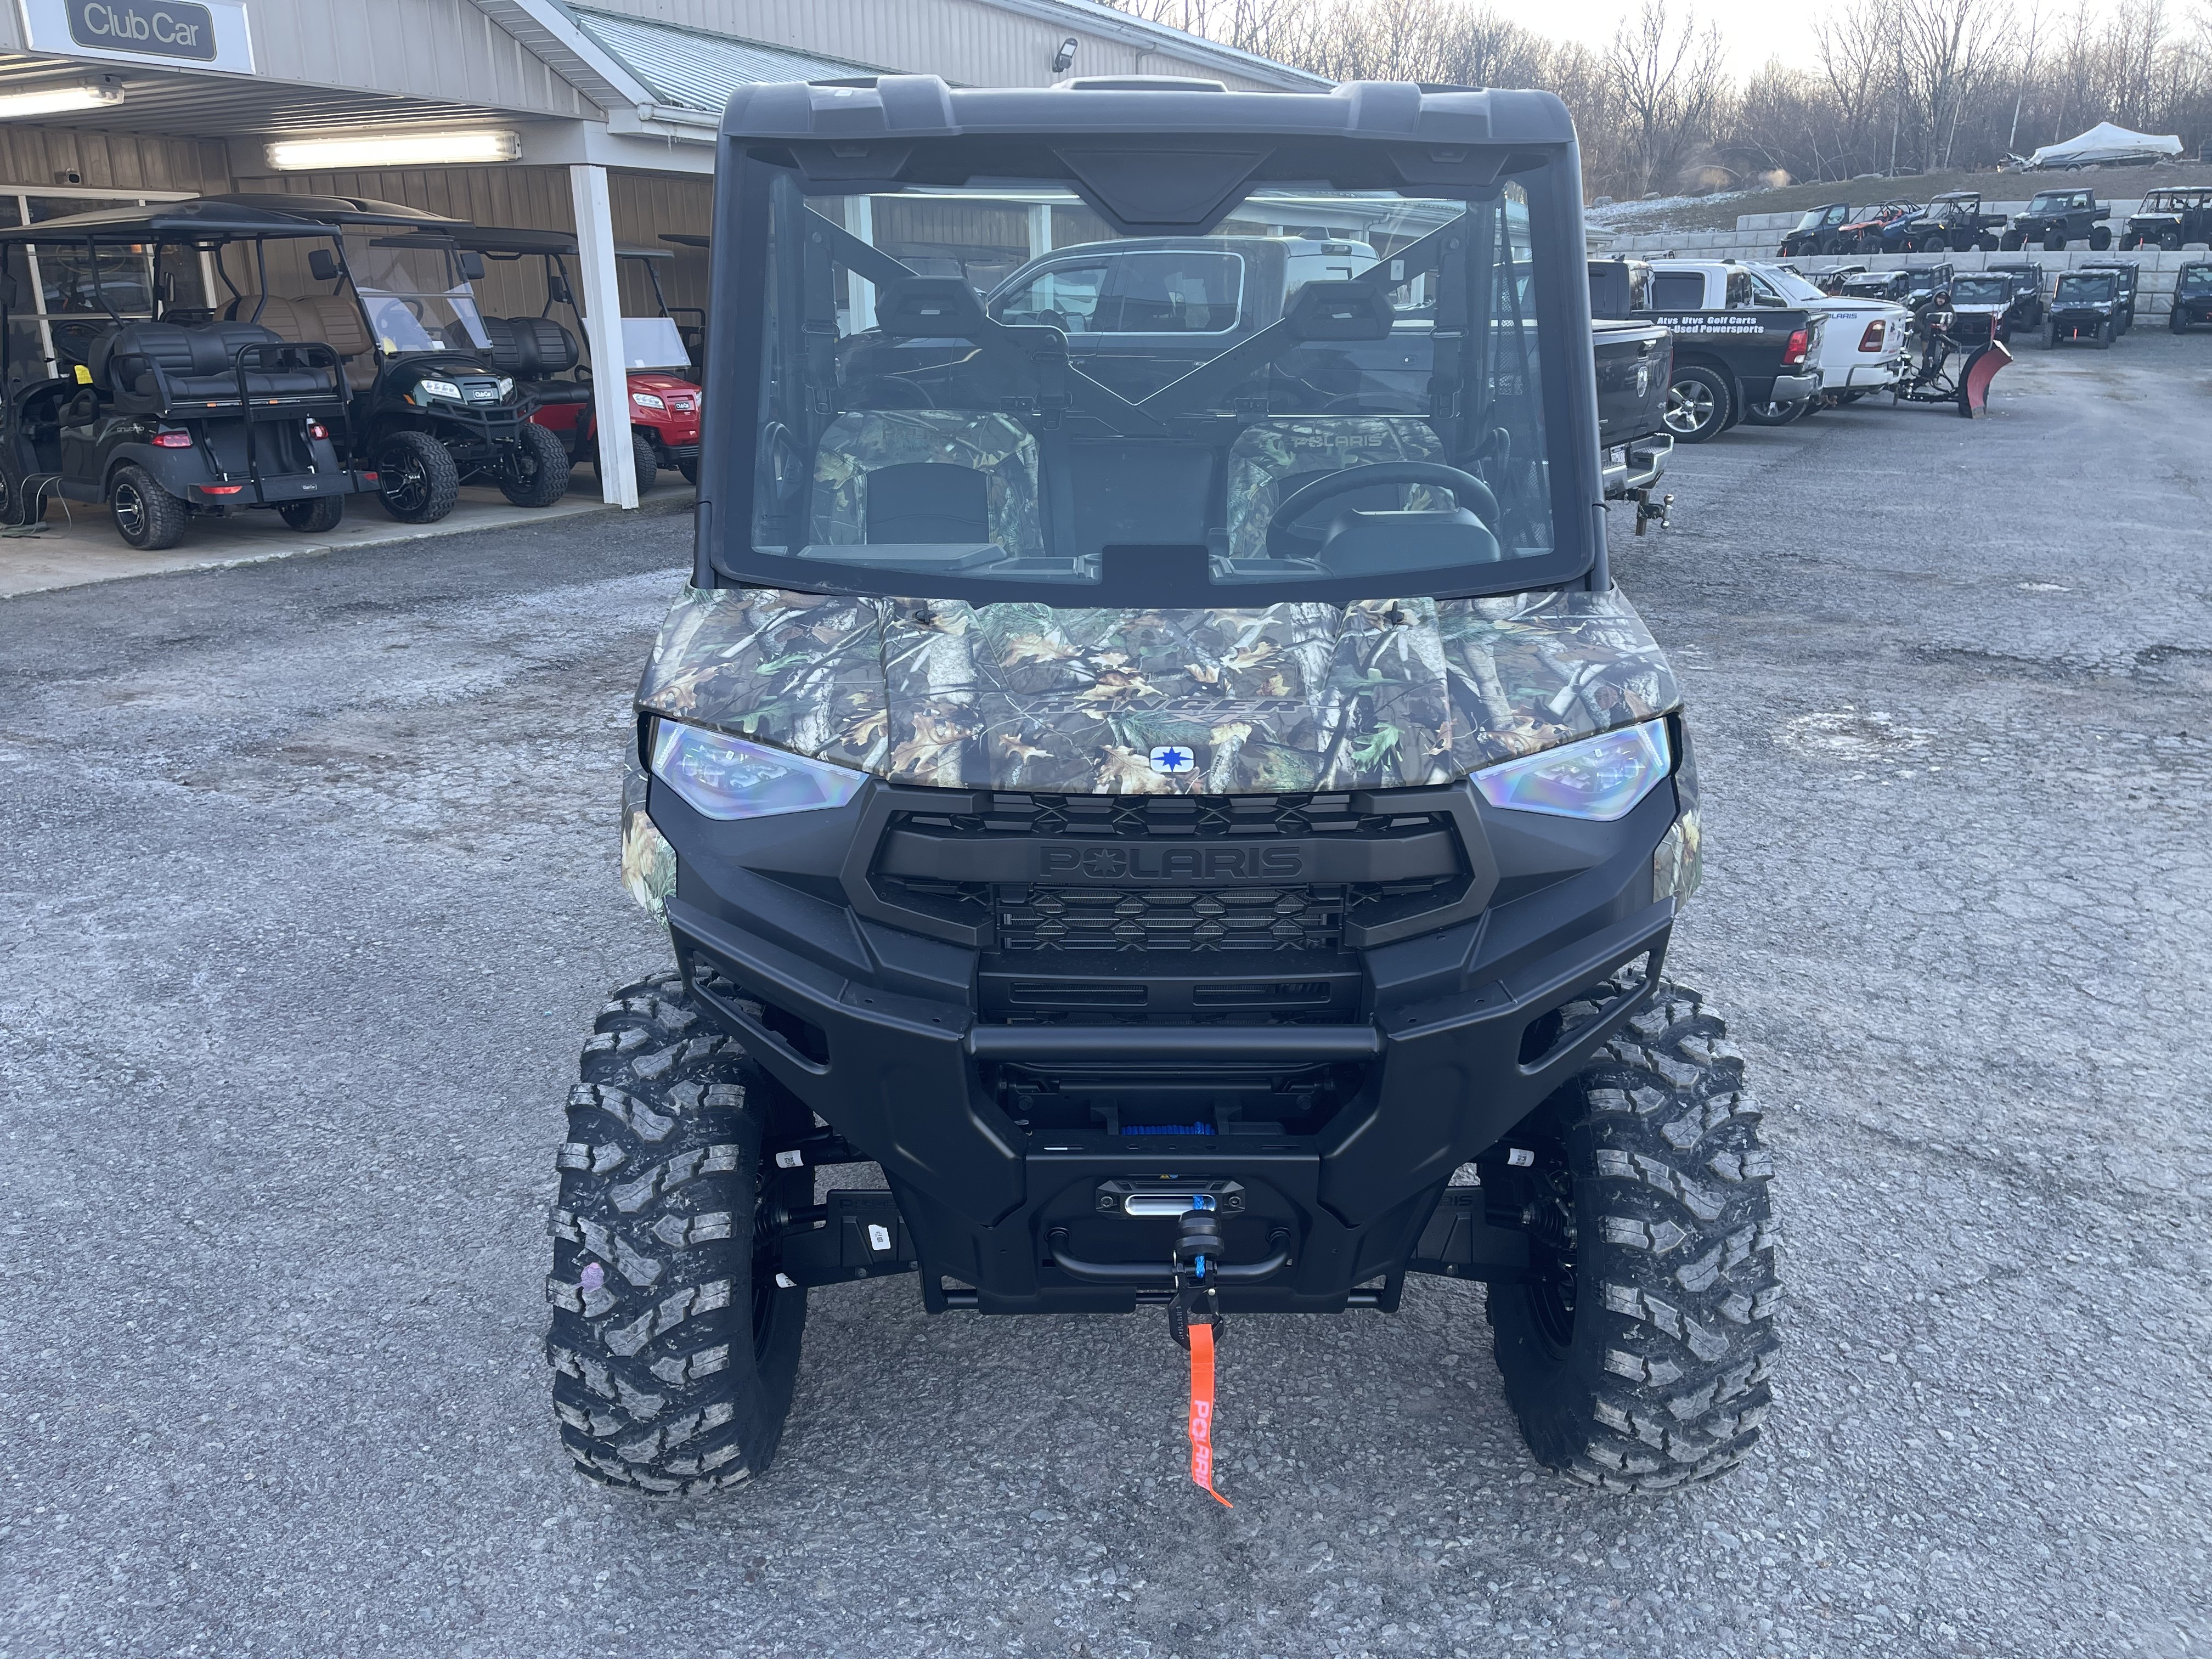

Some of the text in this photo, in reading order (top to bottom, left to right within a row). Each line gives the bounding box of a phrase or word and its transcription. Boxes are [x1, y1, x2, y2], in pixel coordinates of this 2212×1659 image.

[84, 3, 199, 46] Club Car
[1700, 325, 1764, 334] Powersports
[1293, 435, 1382, 448] POLARIS
[1022, 699, 1305, 713] RANGER
[1158, 713, 1273, 724] XP
[1040, 847, 1303, 879] POLARIS
